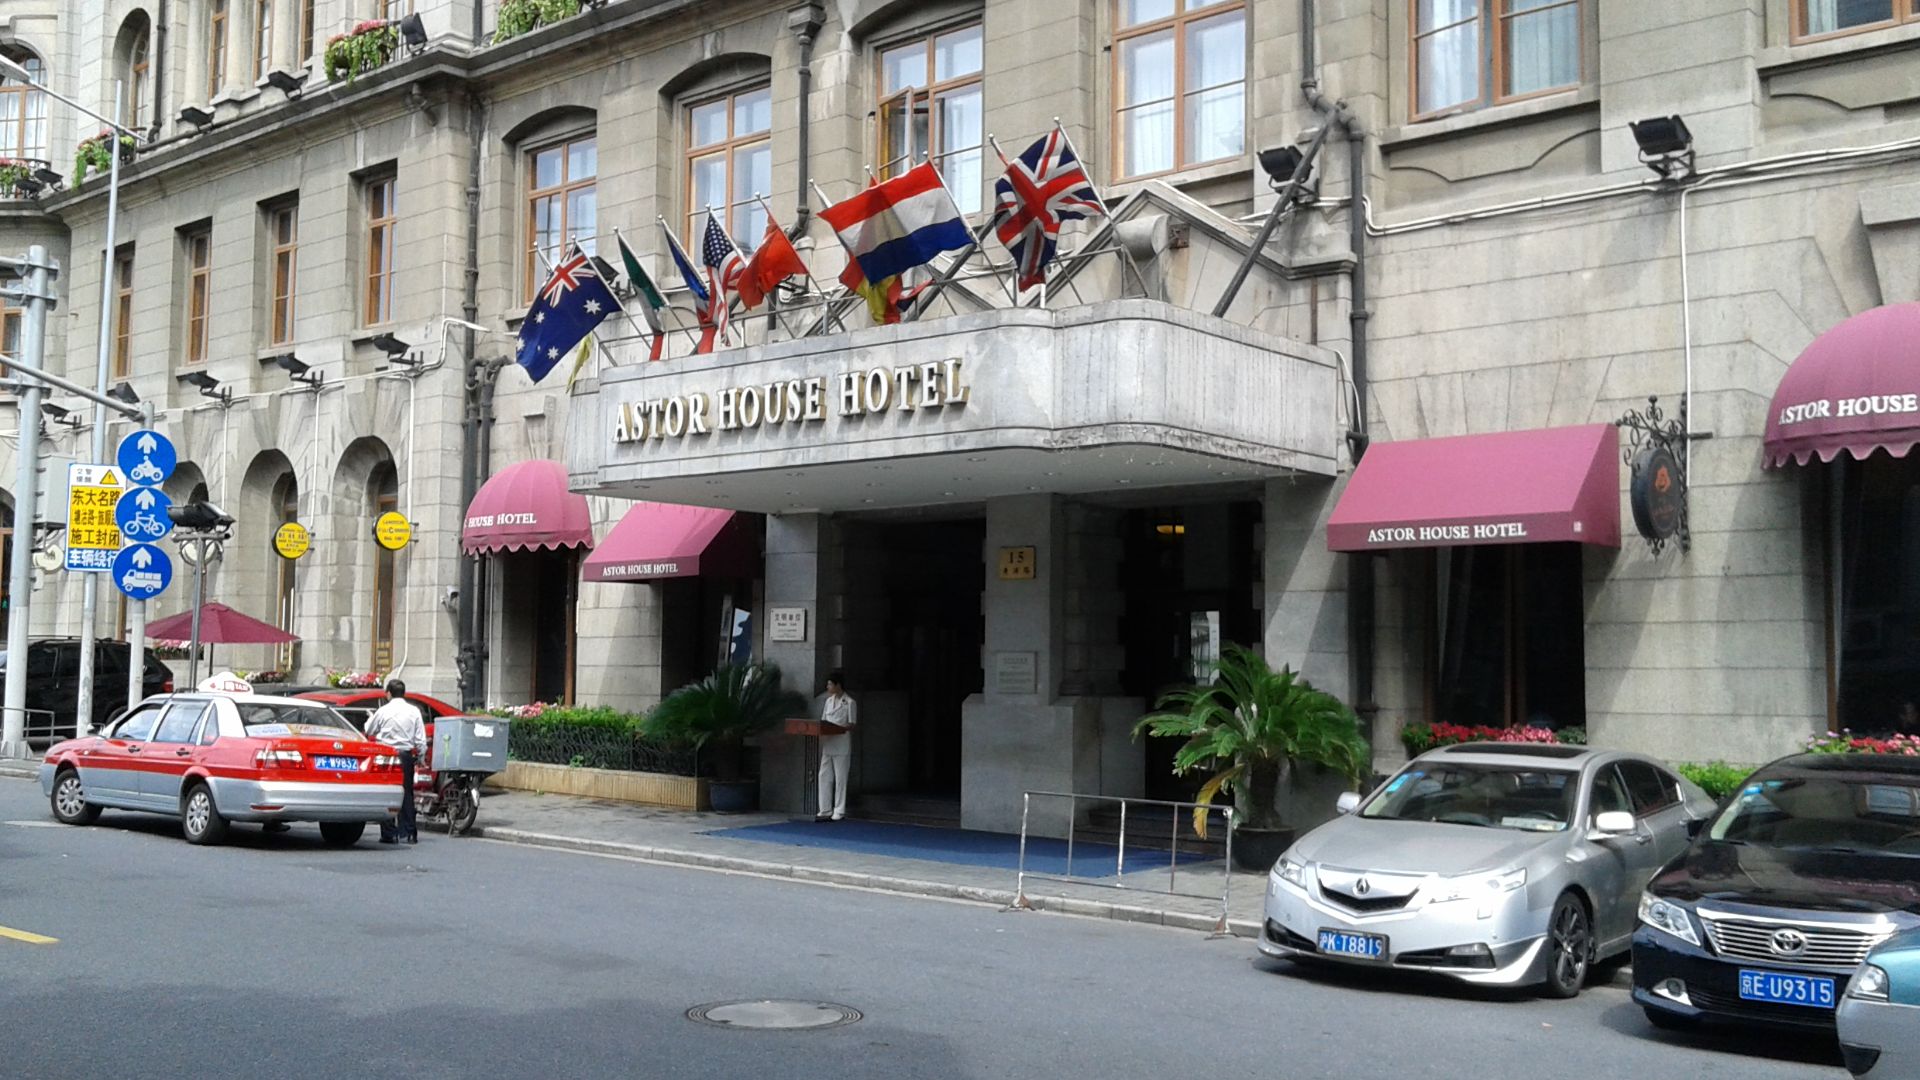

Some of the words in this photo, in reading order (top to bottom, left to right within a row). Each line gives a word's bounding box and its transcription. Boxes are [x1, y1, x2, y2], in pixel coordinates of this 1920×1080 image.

[612, 392, 711, 442] ASTOR
[717, 376, 826, 430] HOUSE
[838, 357, 970, 416] HOTEL
[1779, 400, 1830, 425] ASTOR
[1837, 394, 1918, 417] HOUSE
[468, 515, 494, 528] HOUSE
[497, 512, 537, 525] HOTEL
[70, 528, 119, 546] 施工封闭
[1368, 528, 1416, 542] ASTOR
[1420, 525, 1470, 540] HOUSE
[1474, 522, 1527, 538] HOTEL
[1009, 551, 1024, 564] 15
[602, 566, 626, 577] ASTOR
[628, 564, 651, 575] HOUSE
[653, 563, 678, 574] HOTEL
